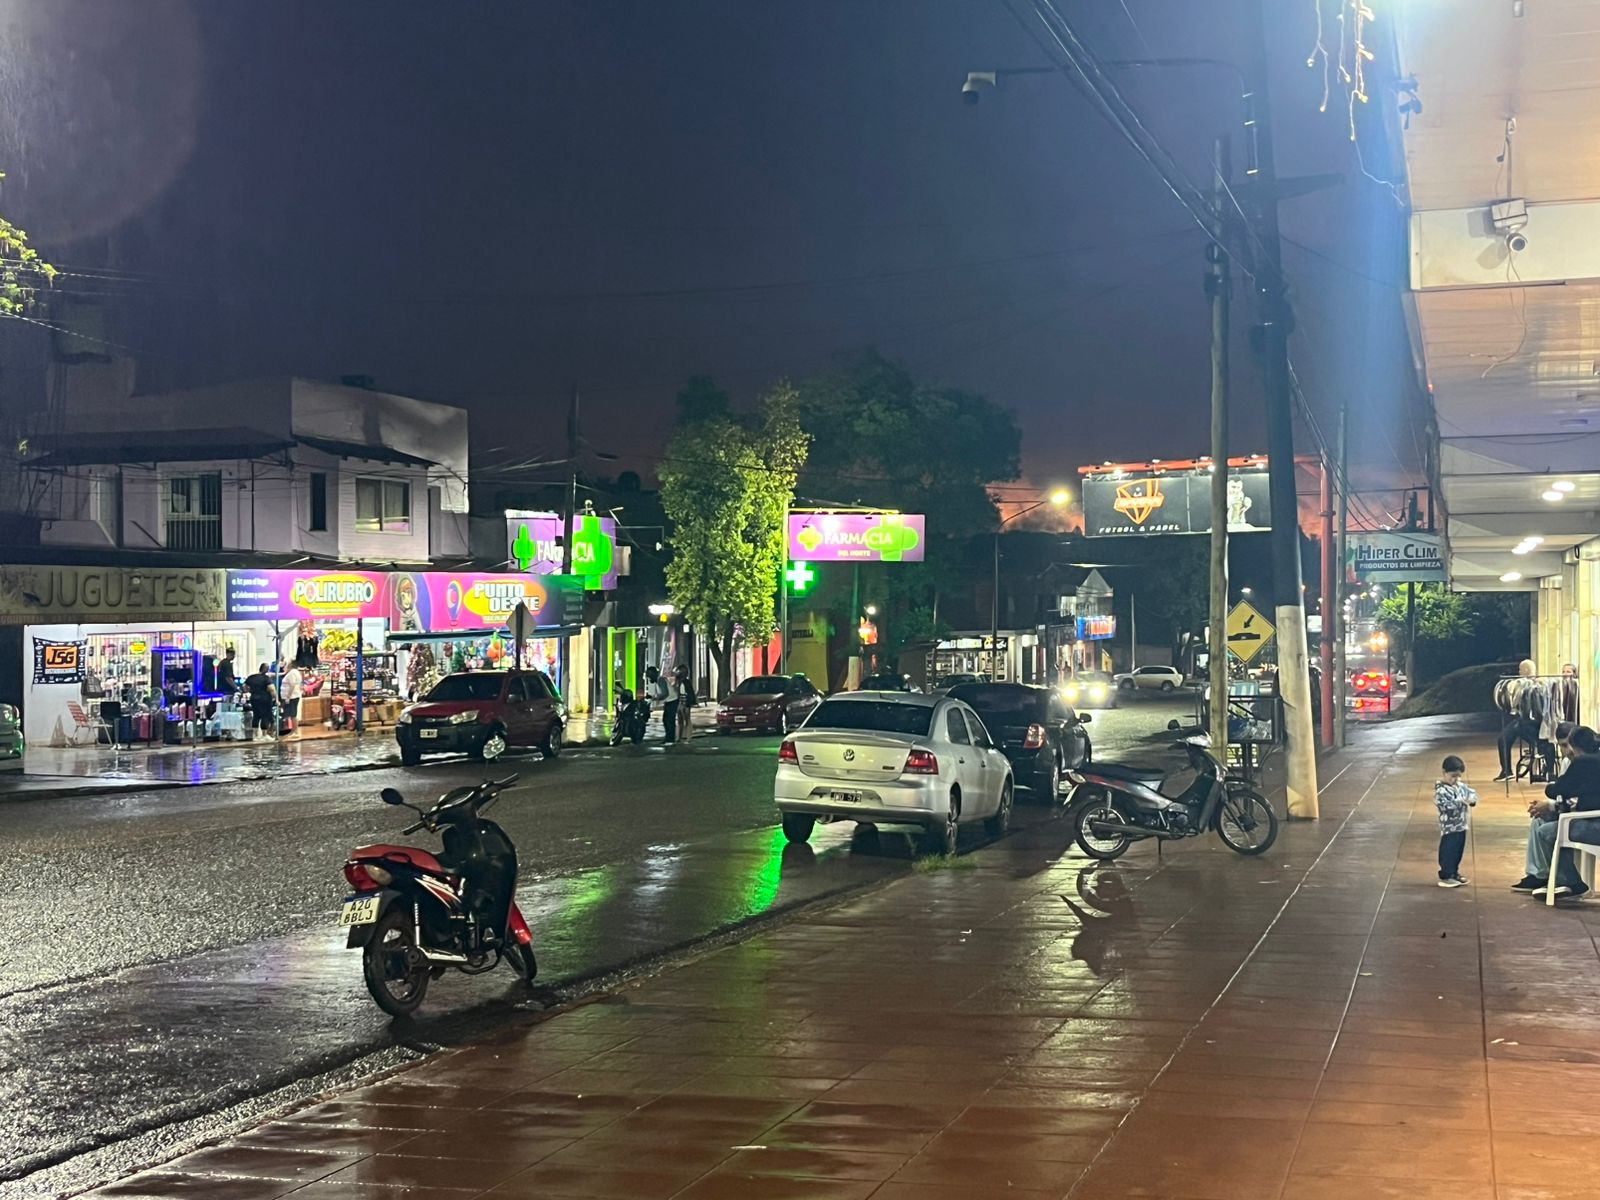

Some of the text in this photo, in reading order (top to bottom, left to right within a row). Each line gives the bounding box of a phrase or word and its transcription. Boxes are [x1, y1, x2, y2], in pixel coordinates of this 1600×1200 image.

[824, 532, 894, 545] FARMACIA
[536, 540, 596, 562] FARCIA
[1358, 544, 1437, 560] HIPER CLIM
[39, 571, 196, 608] JUGUETES
[295, 580, 375, 604] POLIRUBRO
[473, 583, 526, 598] PUNTO
[46, 648, 75, 665] JSG
